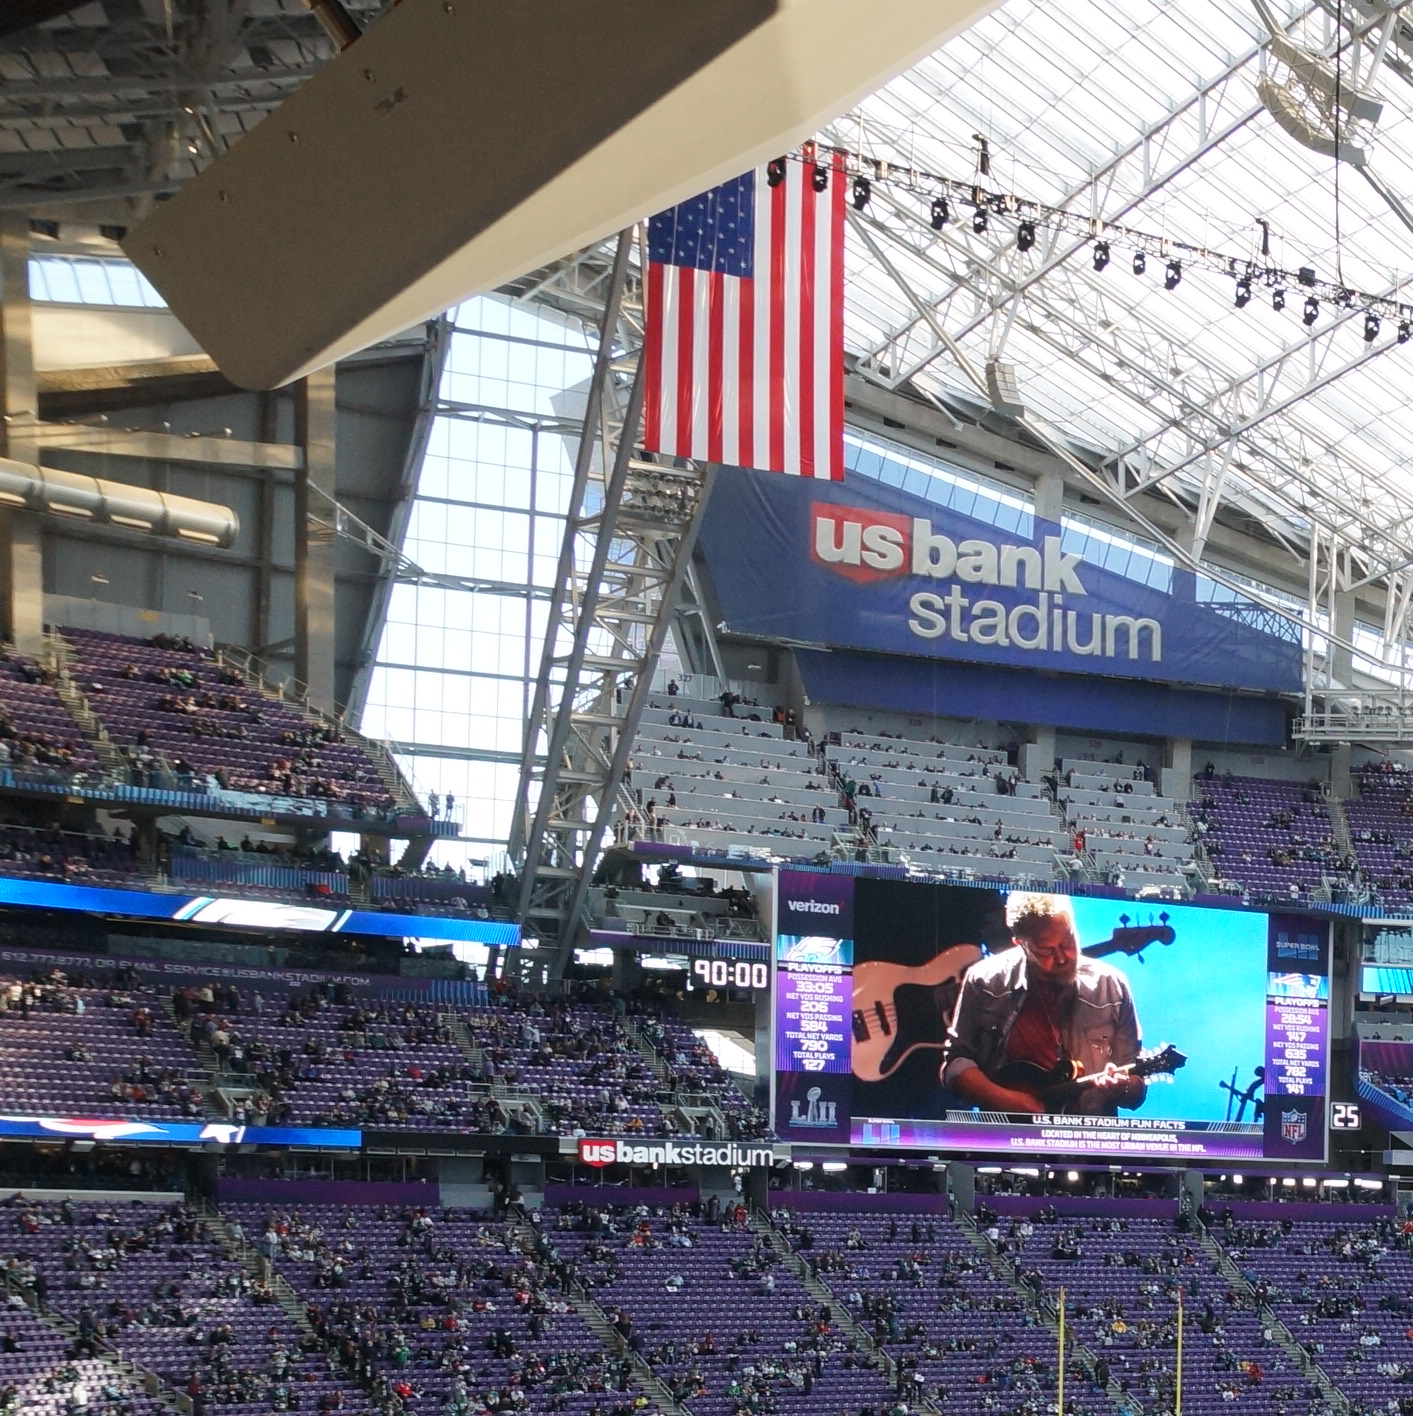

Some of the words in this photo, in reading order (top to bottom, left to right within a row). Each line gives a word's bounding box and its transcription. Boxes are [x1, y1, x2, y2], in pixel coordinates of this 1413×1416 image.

[908, 584, 1163, 662] stadium
[788, 900, 839, 914] verizon
[1276, 941, 1299, 949] SUPER
[1301, 943, 1320, 951] BOWL
[695, 960, 767, 988] 90:00
[788, 963, 842, 974] PLAYOFFS
[828, 975, 842, 983] AVG
[796, 982, 834, 994] 33:05
[814, 994, 843, 1002] RUSHING
[1275, 997, 1319, 1007] PLAYOFFS
[800, 1001, 828, 1013] 206
[787, 1012, 799, 1020] NET
[800, 1021, 827, 1032] 584
[785, 1032, 806, 1040] TOTAL
[808, 1032, 821, 1040] NET
[822, 1033, 843, 1041] YARDS
[1287, 1031, 1306, 1041] 147
[801, 1040, 827, 1051] 790
[793, 1051, 814, 1059] TOTAL
[816, 1052, 835, 1060] PLAYS
[803, 1059, 825, 1071] 127
[1296, 1077, 1312, 1085] PLAYS
[1033, 1115, 1051, 1124] U.S.
[1054, 1117, 1082, 1125] BANK
[1084, 1118, 1129, 1127] STADIUM
[1131, 1120, 1151, 1128] FUN
[1153, 1120, 1185, 1129] FACTS
[1334, 1105, 1360, 1128] 25
[1042, 1130, 1072, 1138] LOCATED
[1074, 1131, 1081, 1139] IN
[1083, 1131, 1096, 1139] THE
[1097, 1132, 1120, 1140] HEART
[1284, 1123, 1304, 1137] NFL
[1026, 1139, 1045, 1147] BANK
[1047, 1139, 1078, 1148] STADIUM
[1086, 1140, 1100, 1149] THE
[1178, 1144, 1190, 1152] THE
